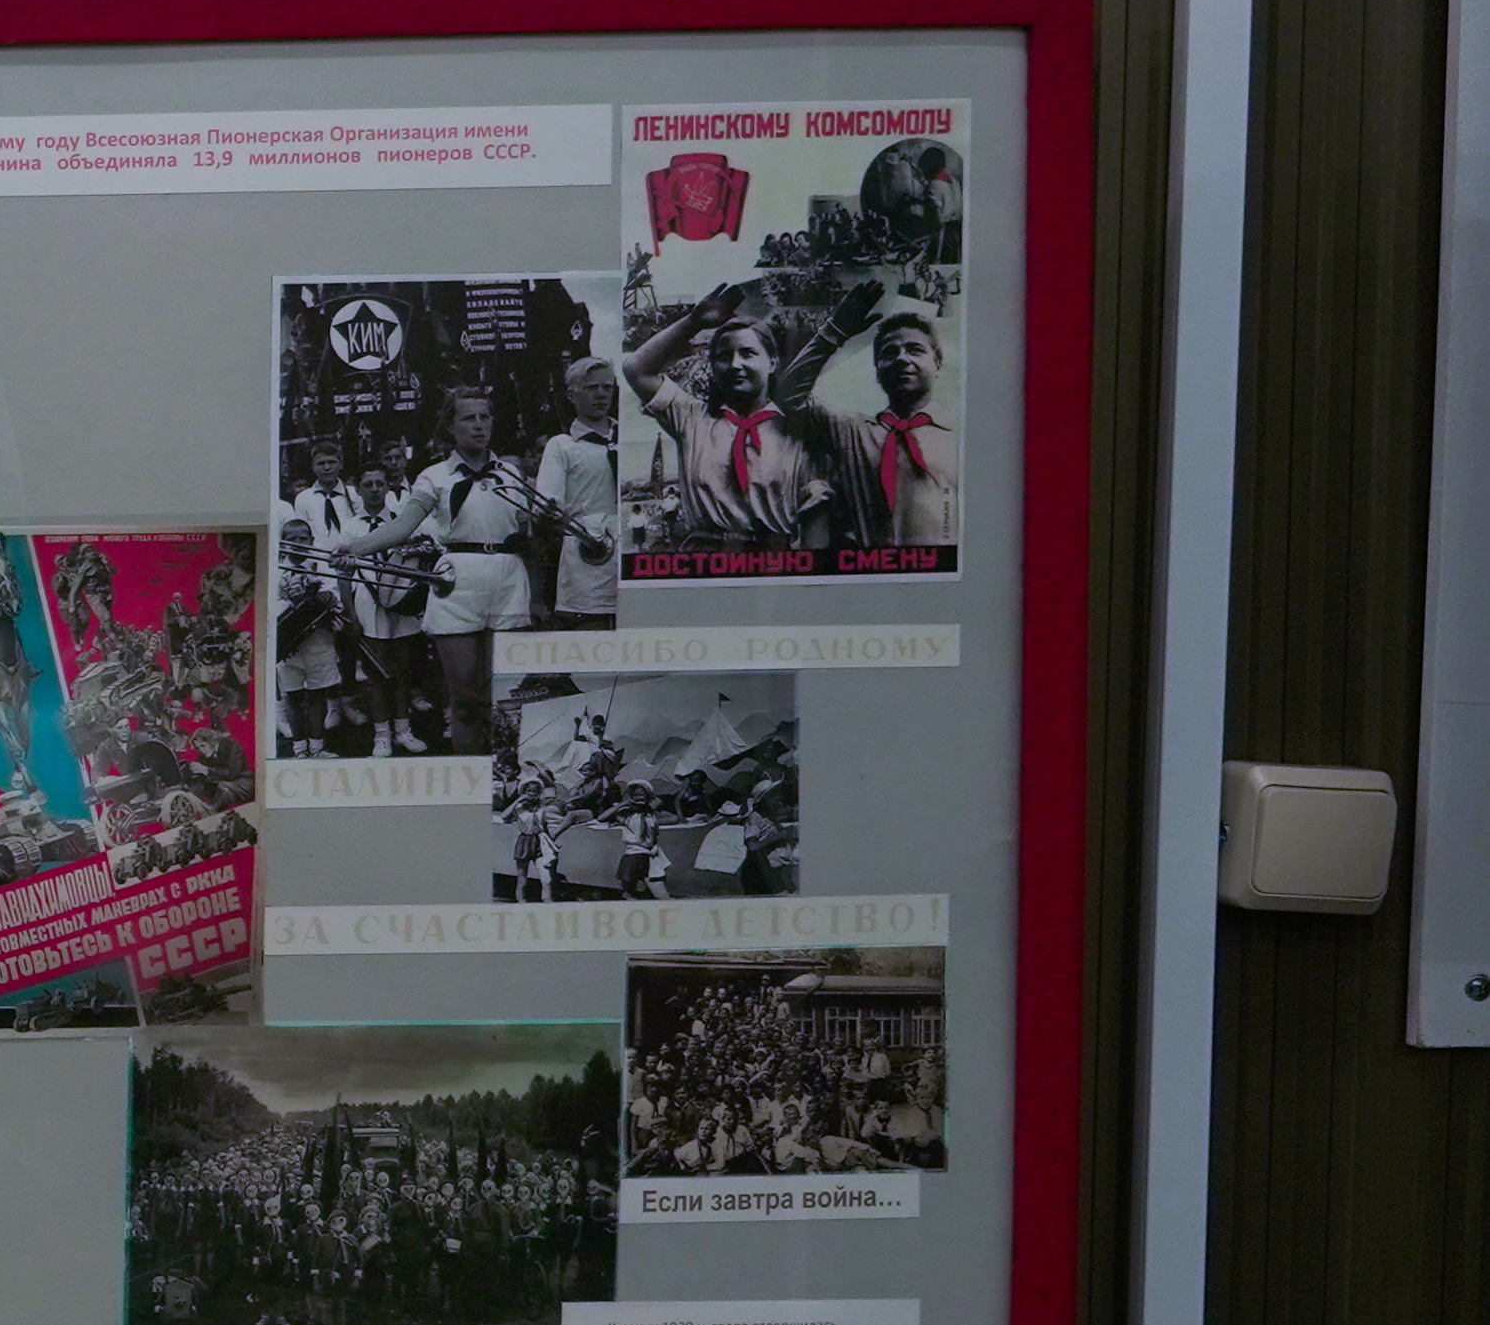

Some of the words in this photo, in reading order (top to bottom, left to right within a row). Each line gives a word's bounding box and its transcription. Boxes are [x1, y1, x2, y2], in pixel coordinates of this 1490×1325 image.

[36, 135, 80, 151] году
[85, 132, 201, 147] Всесоюзная
[207, 128, 323, 145] Пионерская
[329, 126, 458, 143] Организация
[464, 125, 528, 138] имени
[633, 111, 790, 142] ЛЕНИНСКОМУ
[806, 108, 952, 138] КОМСОМОЛУ
[57, 153, 177, 171] объединяла
[193, 150, 233, 168] 13,9
[248, 150, 361, 165] миллионов
[377, 148, 473, 163] пионеров
[483, 143, 536, 159] СССР.
[347, 321, 386, 354] КИМ
[837, 548, 937, 571] СМЕНУ
[505, 637, 709, 667] СПАСИБО
[746, 634, 953, 664] РОДНОМУ
[273, 764, 487, 800] СТАЛИНУ
[91, 886, 167, 928] МАНЕВРАХ
[171, 881, 181, 898] С
[186, 864, 235, 893] РККА
[117, 922, 135, 946] К
[139, 887, 241, 938] ОБОРОНЕ
[273, 914, 329, 947] ЗА
[354, 907, 679, 946] СЧАСТЛИВОЕ
[137, 917, 248, 977] СССР
[642, 1189, 702, 1212] Если
[710, 1192, 793, 1213] завтра
